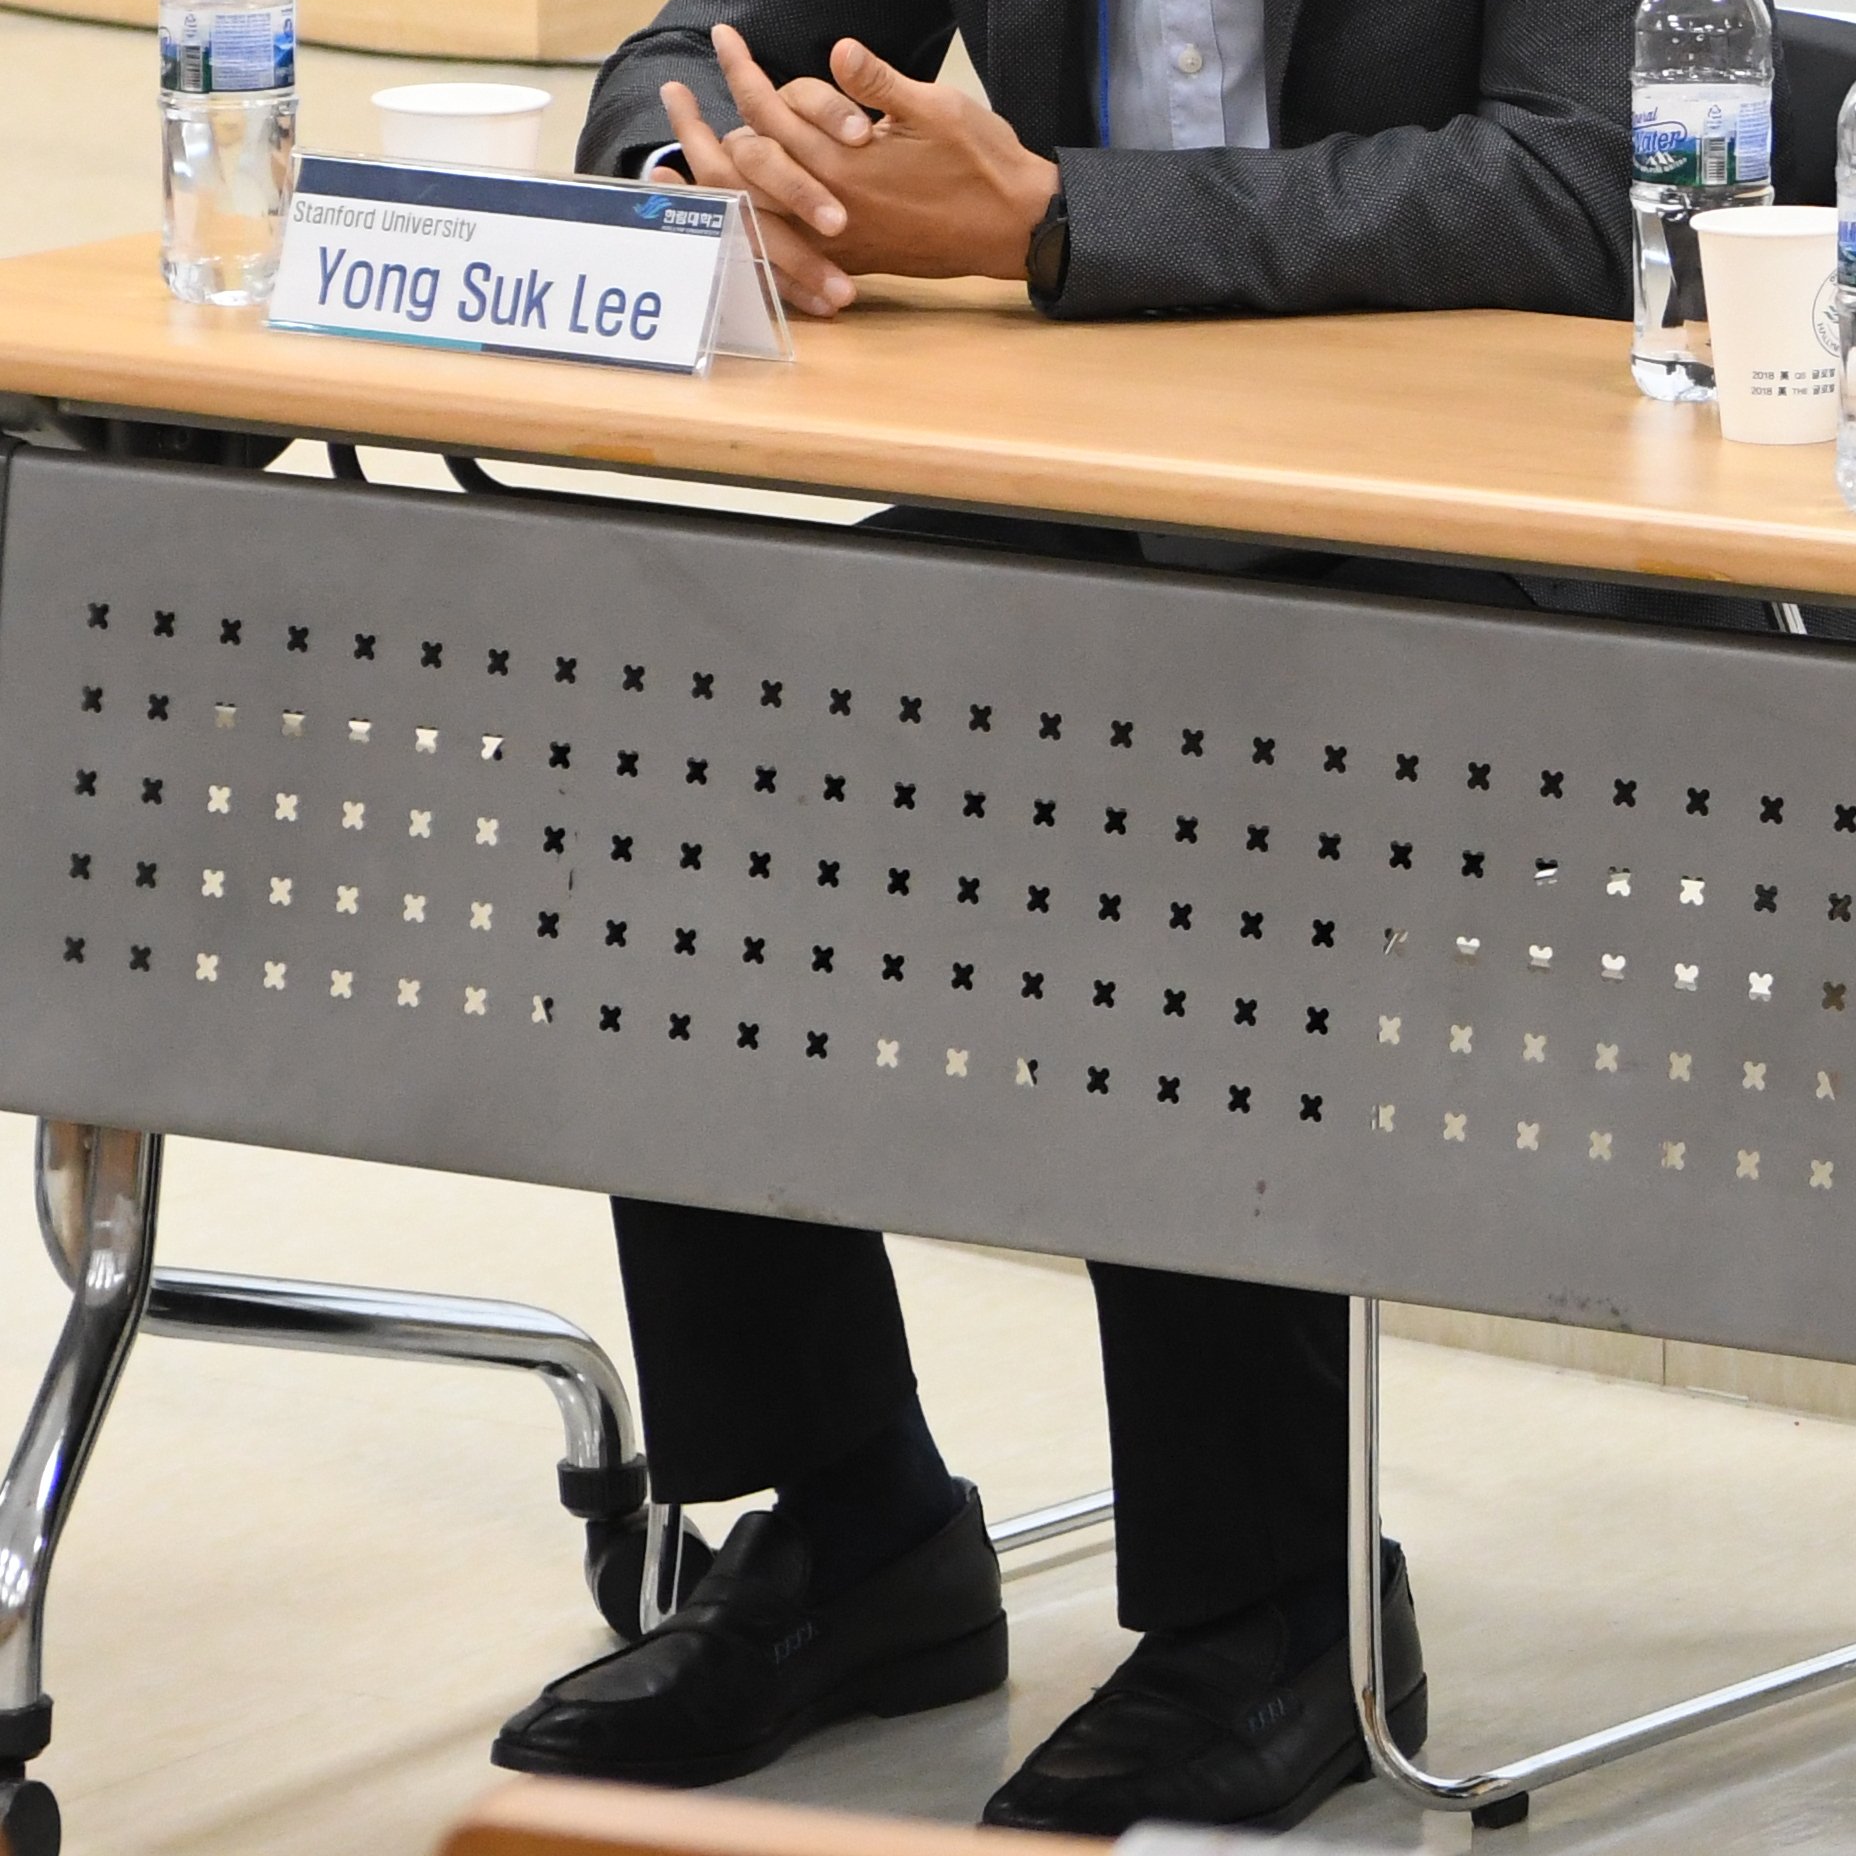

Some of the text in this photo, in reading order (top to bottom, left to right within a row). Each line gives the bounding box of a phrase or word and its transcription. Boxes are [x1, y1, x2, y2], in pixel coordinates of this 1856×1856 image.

[293, 200, 477, 243] Stanford University
[662, 207, 724, 229] 한림대학교
[317, 245, 662, 342] Yong Suk Lee
[1751, 370, 1775, 380] 2018
[1751, 386, 1773, 396] 2018
